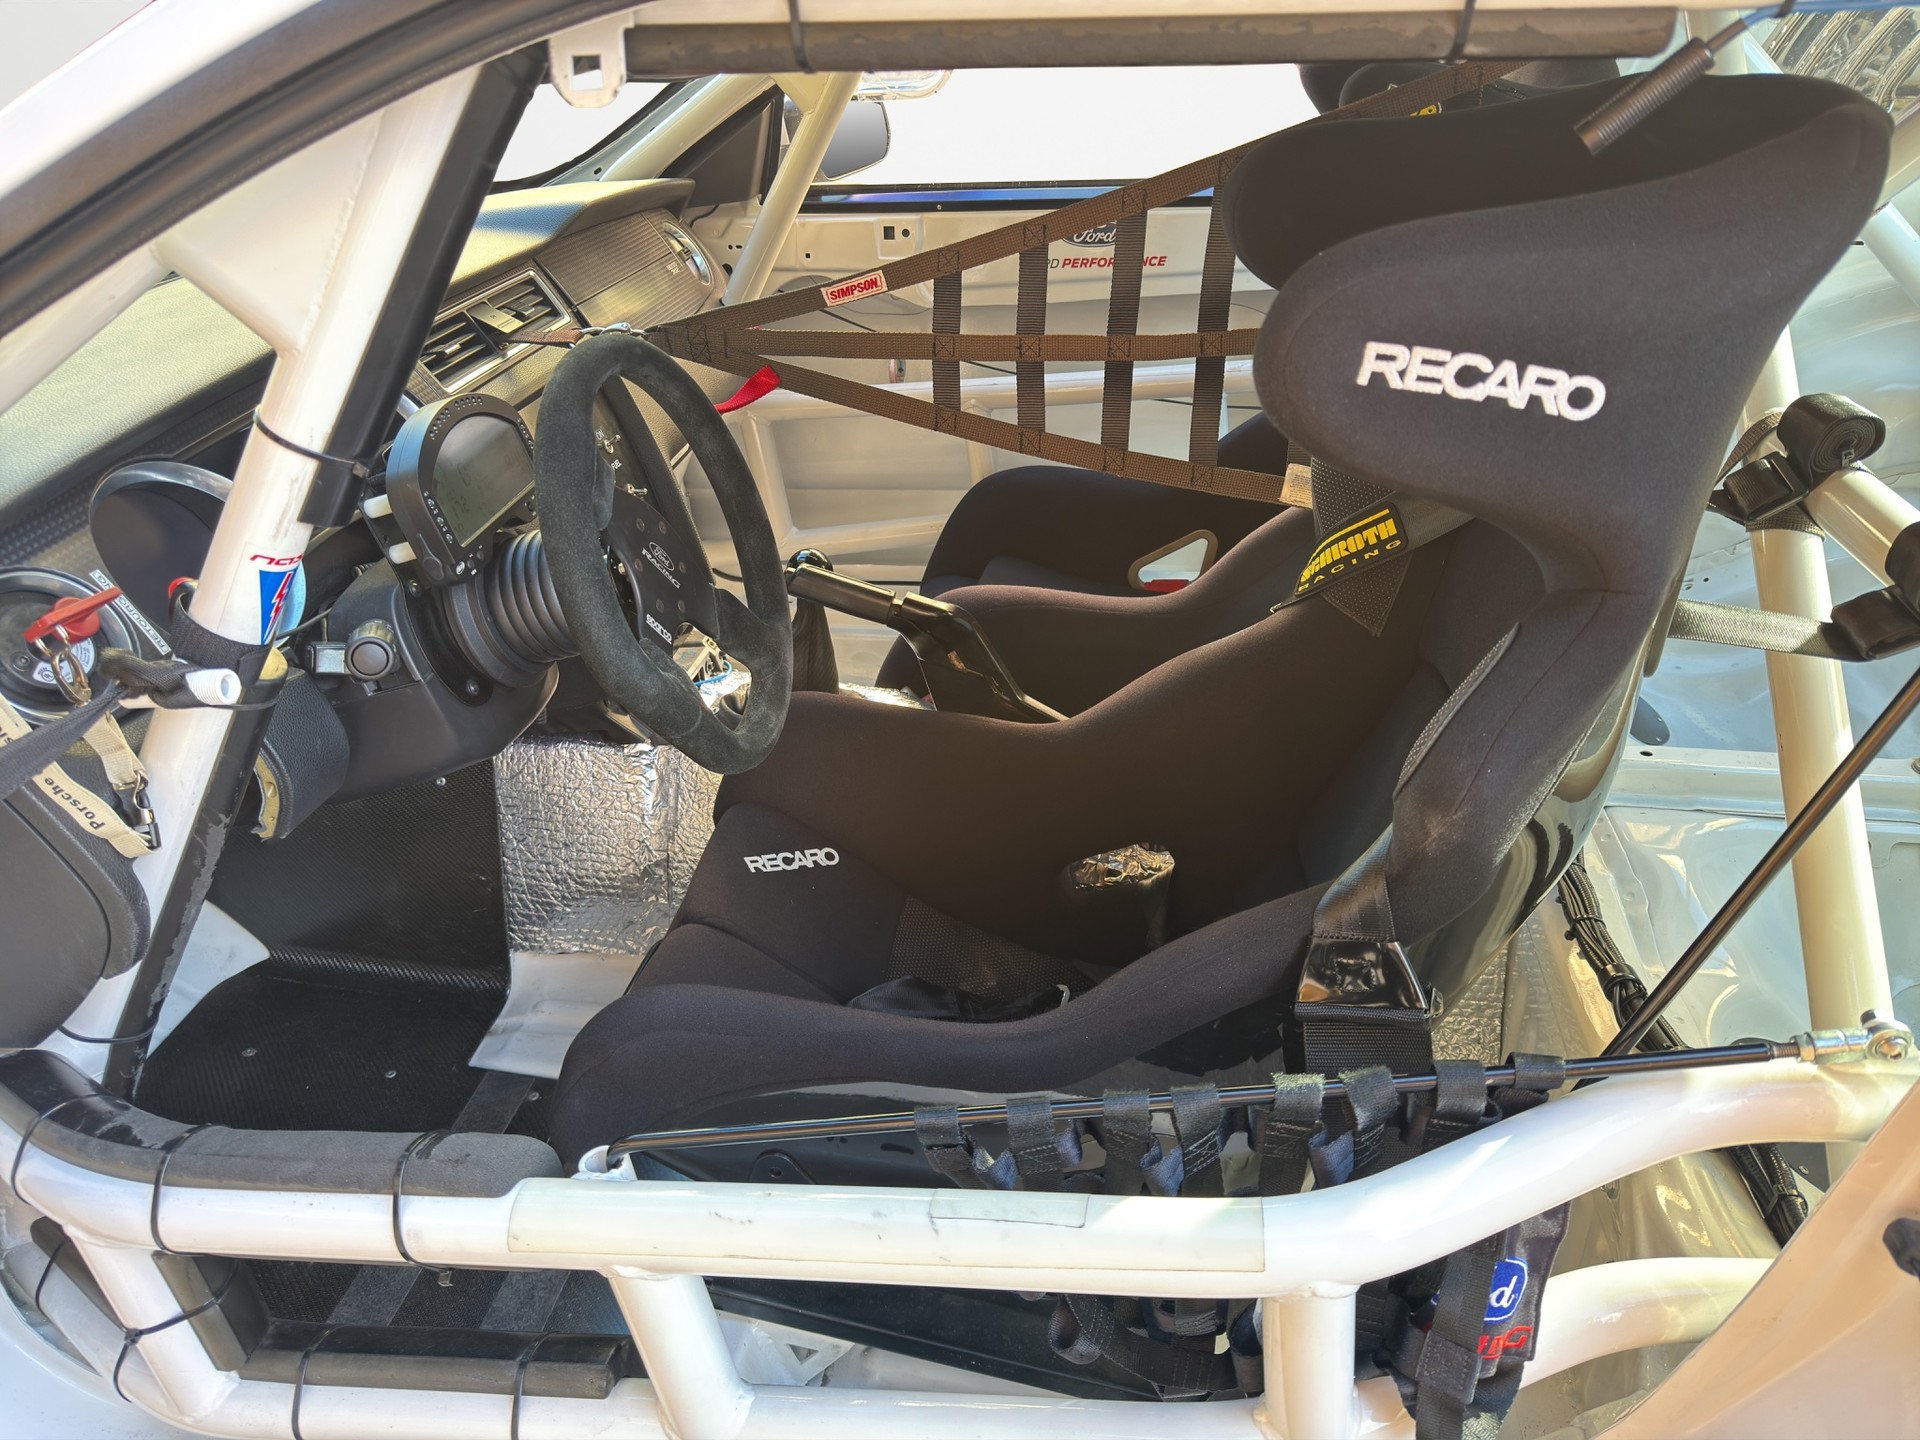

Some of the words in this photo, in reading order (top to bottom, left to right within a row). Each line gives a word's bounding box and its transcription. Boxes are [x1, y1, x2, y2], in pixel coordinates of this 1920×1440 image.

[829, 277, 879, 301] SIMPSON
[1356, 341, 1606, 421] RECARO
[641, 547, 681, 589] RACING
[1297, 539, 1402, 592] RACING
[97, 575, 166, 648] RETOURGNG
[44, 777, 106, 830] Porsche
[743, 847, 840, 873] RECARO
